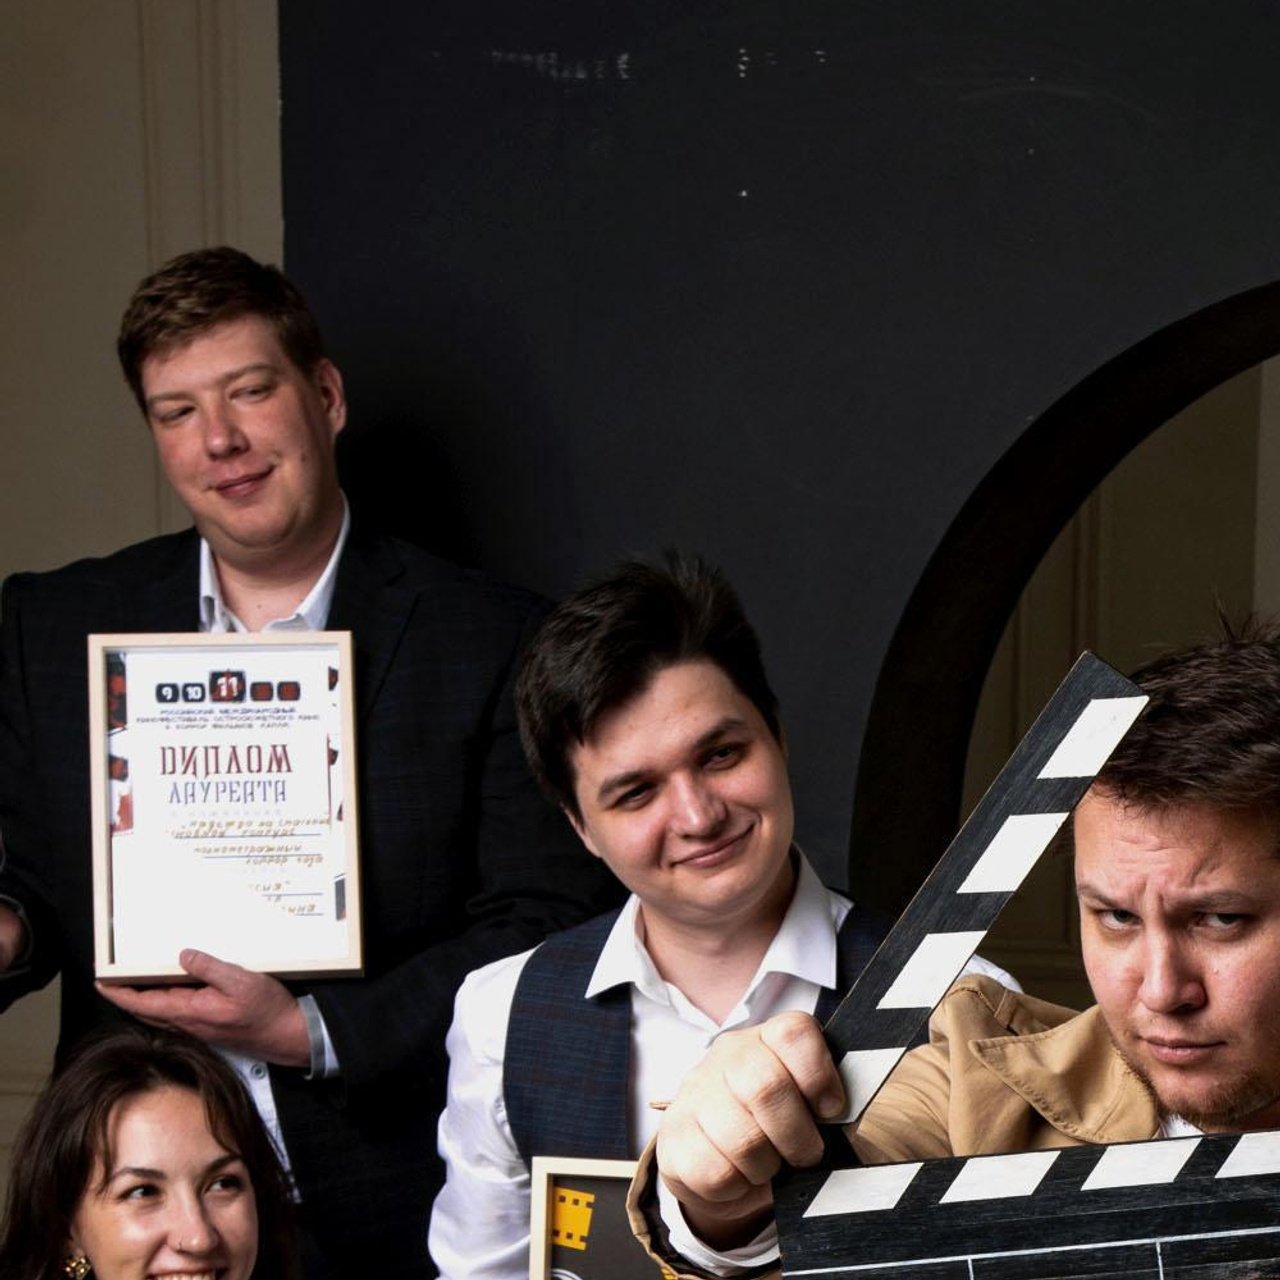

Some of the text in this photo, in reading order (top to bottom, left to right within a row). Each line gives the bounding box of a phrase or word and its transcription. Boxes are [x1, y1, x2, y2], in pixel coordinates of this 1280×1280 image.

[162, 676, 239, 700] 9 10 11
[160, 744, 293, 778] ДИПЛОМ
[169, 779, 287, 805] ЛАУРЕАТА
